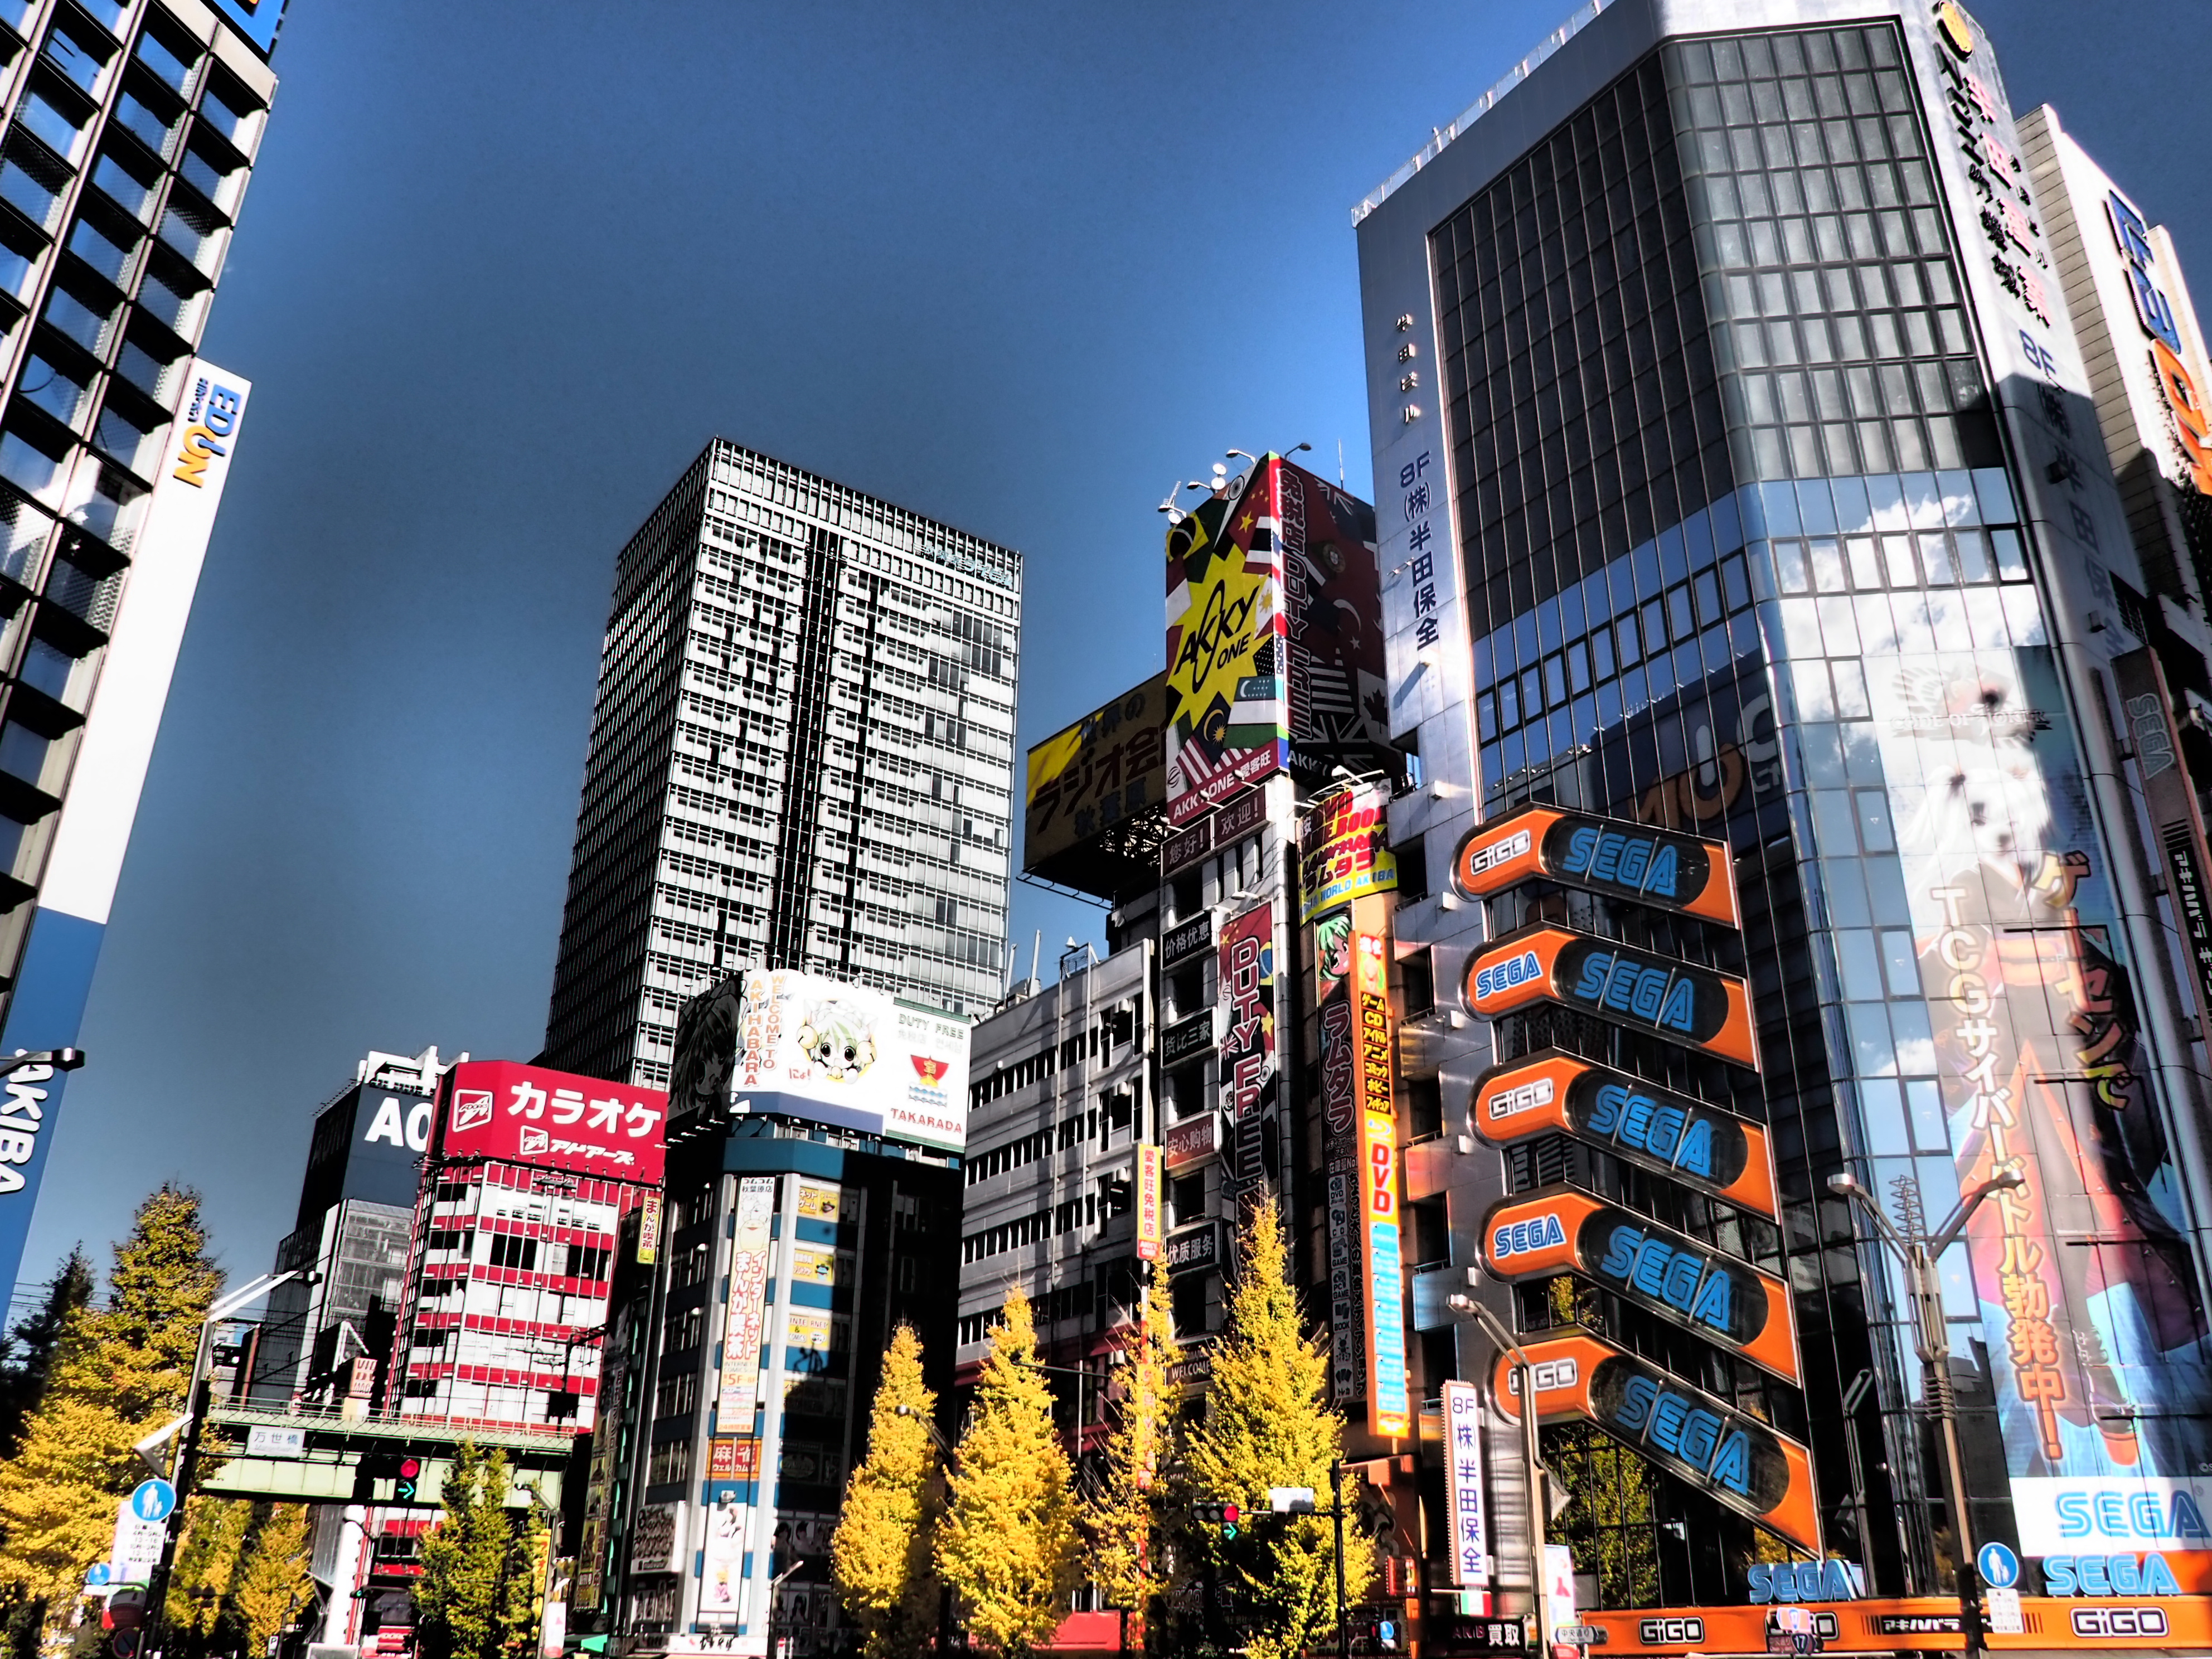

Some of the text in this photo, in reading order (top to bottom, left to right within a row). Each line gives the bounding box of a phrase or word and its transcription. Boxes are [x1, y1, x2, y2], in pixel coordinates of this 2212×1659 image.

[2019, 329, 2058, 376] 8F
[173, 382, 242, 488] EDION
[1400, 450, 1431, 488] 8F
[1216, 631, 1252, 670] ONE
[1281, 549, 1312, 744] DUTY FREE
[1890, 715, 1943, 730] CODE
[1949, 713, 1969, 726] OF
[2126, 691, 2175, 780] SEGA
[1032, 718, 1167, 836] ラジオ会
[1310, 790, 1354, 831] DVD
[1562, 827, 1677, 897] SEGA
[1321, 880, 1352, 902] WORLD
[1355, 868, 1395, 887] AKIBA
[2174, 850, 2208, 939] アキハバラ
[1165, 920, 1210, 960] 价格优惠
[1230, 935, 1261, 1052] DUTY
[1361, 993, 1385, 1012] ゲーム
[1476, 950, 1694, 1032] SEGA SEGA
[744, 978, 767, 1088] AKIHABARA
[763, 974, 787, 1070] WELCOME TO
[899, 1013, 964, 1040] DUTY FREE
[1362, 1027, 1387, 1045] アイドル
[1365, 1012, 1383, 1027] CD
[1165, 1020, 1211, 1058] 货比三家
[1363, 1044, 1388, 1062] アニメ
[1323, 1002, 1354, 1135] ラムタラ
[1365, 1062, 1388, 1078] コミック
[1366, 1079, 1389, 1094] ホビー
[507, 1080, 662, 1138] カラオケ
[890, 1108, 962, 1134] TAKARADA
[1234, 1052, 1263, 1182] FREE
[1366, 1097, 1390, 1113] フィギュア
[1167, 1124, 1212, 1159] 安心购物
[1587, 1083, 1711, 1177] SEGA
[549, 1138, 635, 1166] アドアーズ
[741, 1185, 773, 1194] 秋葉原店
[799, 1189, 818, 1199] ネット
[1330, 1190, 1345, 1199] DVD
[1370, 1143, 1391, 1214] DVD
[798, 1199, 817, 1210] ゲーム
[642, 1198, 659, 1250] まんが喫茶
[1167, 1234, 1214, 1266] 优质服务
[1332, 1257, 1348, 1268] GAME
[1493, 1212, 1730, 1332] SEGA SEGA
[726, 1251, 752, 1360] まんが喫茶
[745, 1250, 766, 1360] インターネット
[1333, 1289, 1350, 1299] GAME
[788, 1333, 806, 1342] COMICS
[1334, 1322, 1350, 1331] BOOK
[1171, 1360, 1211, 1380] WELCOME
[1452, 1397, 1474, 1414] 8F
[254, 1432, 298, 1445] 万世橋
[1507, 1357, 1749, 1496] GGO SEGA
[2056, 1490, 2211, 1539] SEGA
[1748, 1559, 1858, 1603] SEGA
[2043, 1552, 2182, 1595] SEGA
[1488, 1624, 1520, 1647] 買取
[1794, 1635, 1806, 1650] 17
[1883, 1618, 1960, 1632] アキハバラ
